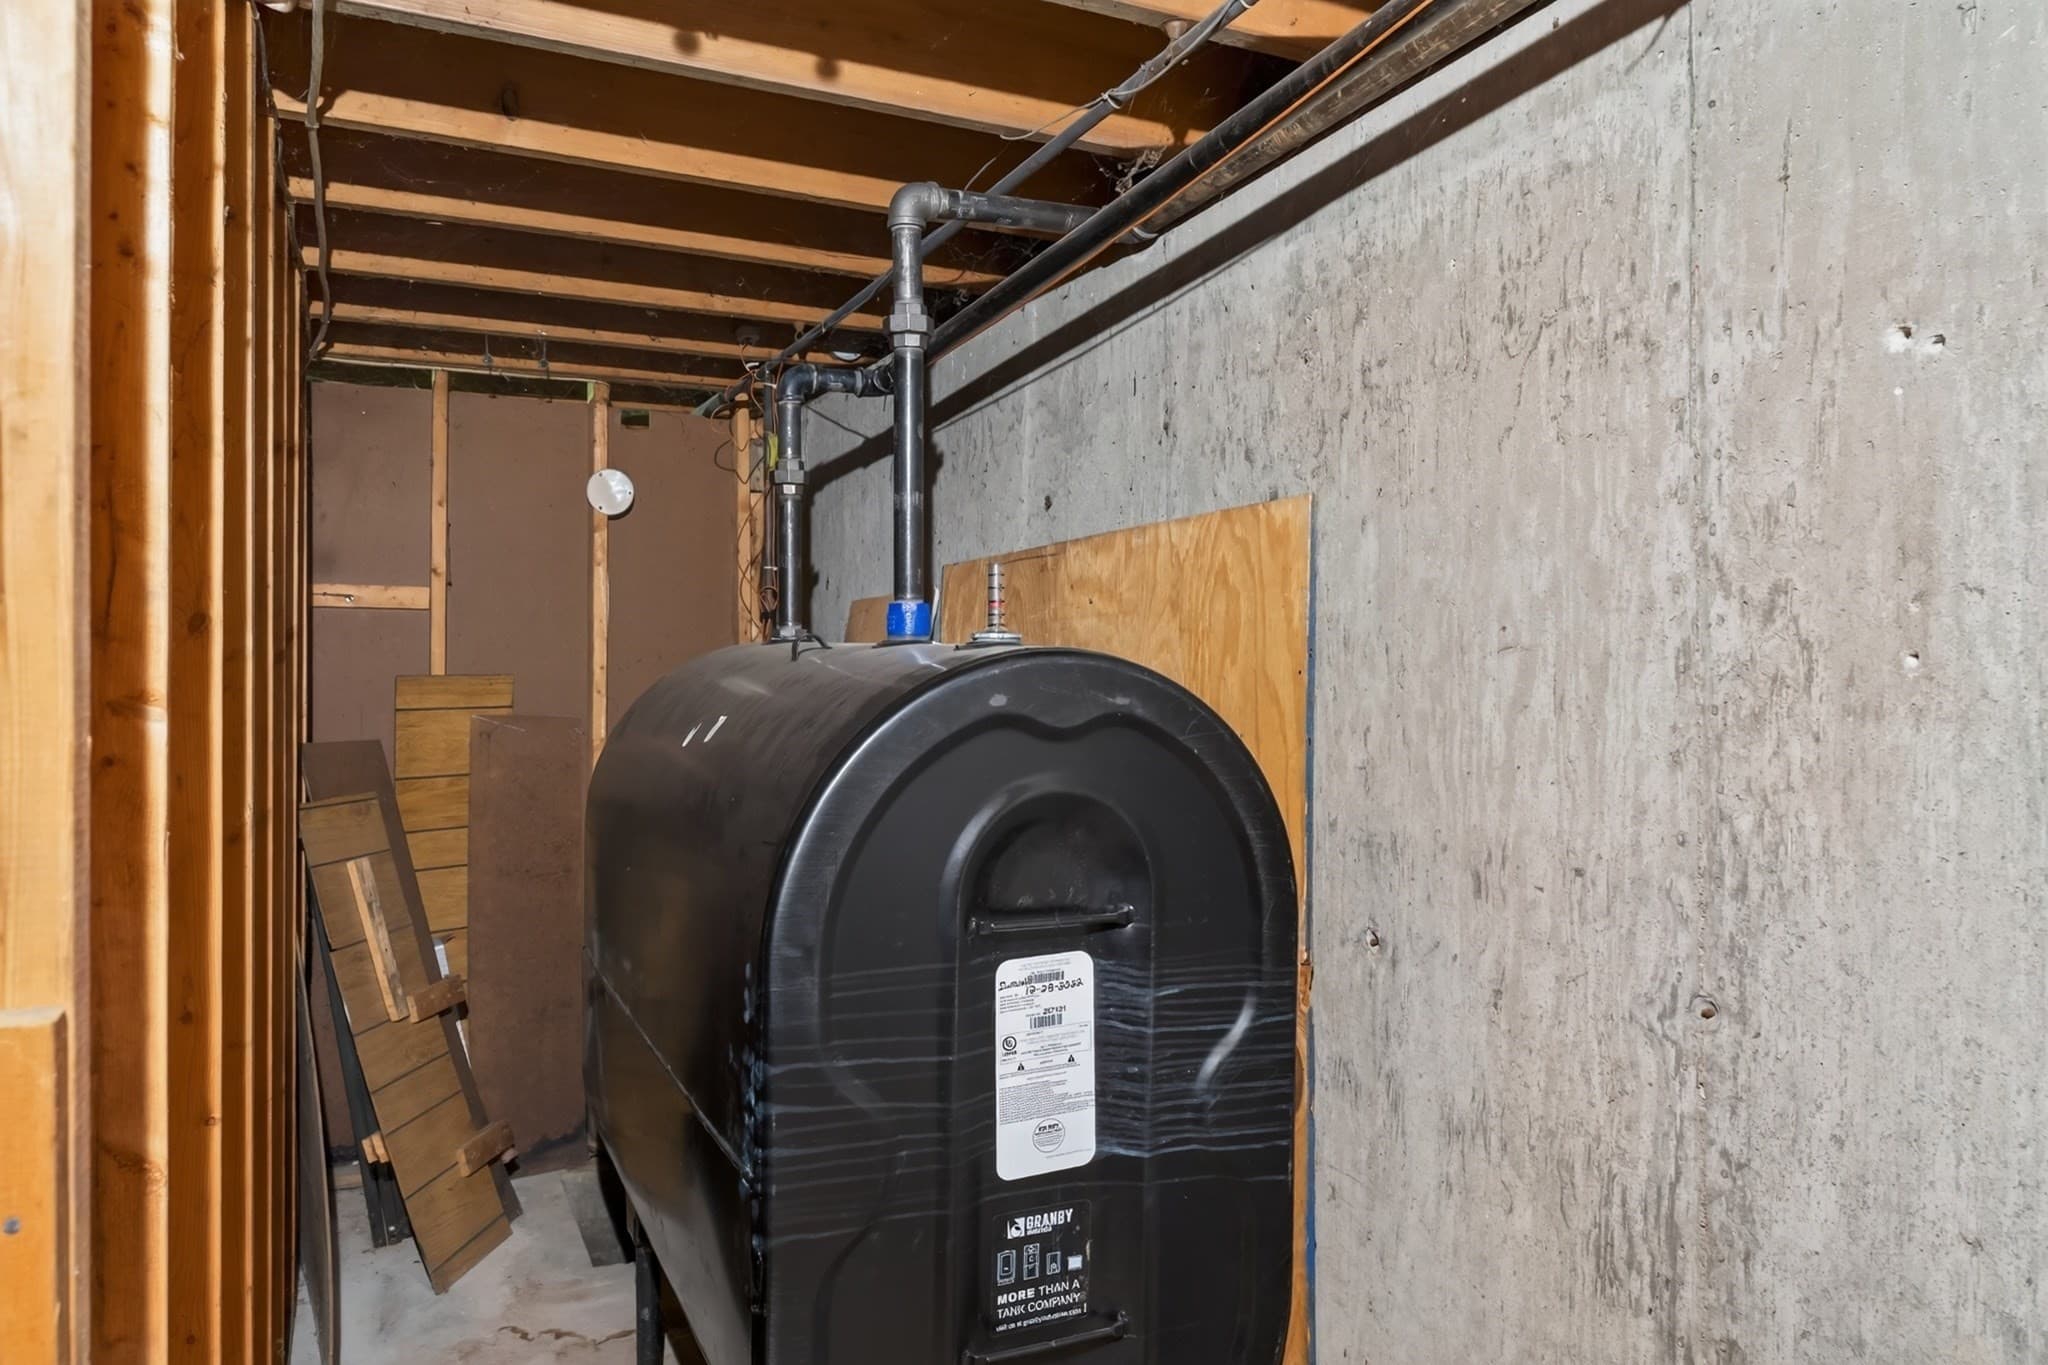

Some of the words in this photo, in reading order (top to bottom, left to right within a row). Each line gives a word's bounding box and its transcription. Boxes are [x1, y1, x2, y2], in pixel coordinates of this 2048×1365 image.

[1027, 1208, 1074, 1229] GRANBY
[997, 1288, 1035, 1305] MORE
[1038, 1282, 1070, 1297] THAN
[1071, 1279, 1081, 1290] A
[997, 1304, 1026, 1319] TANK
[1027, 1292, 1081, 1312] COMPANY
